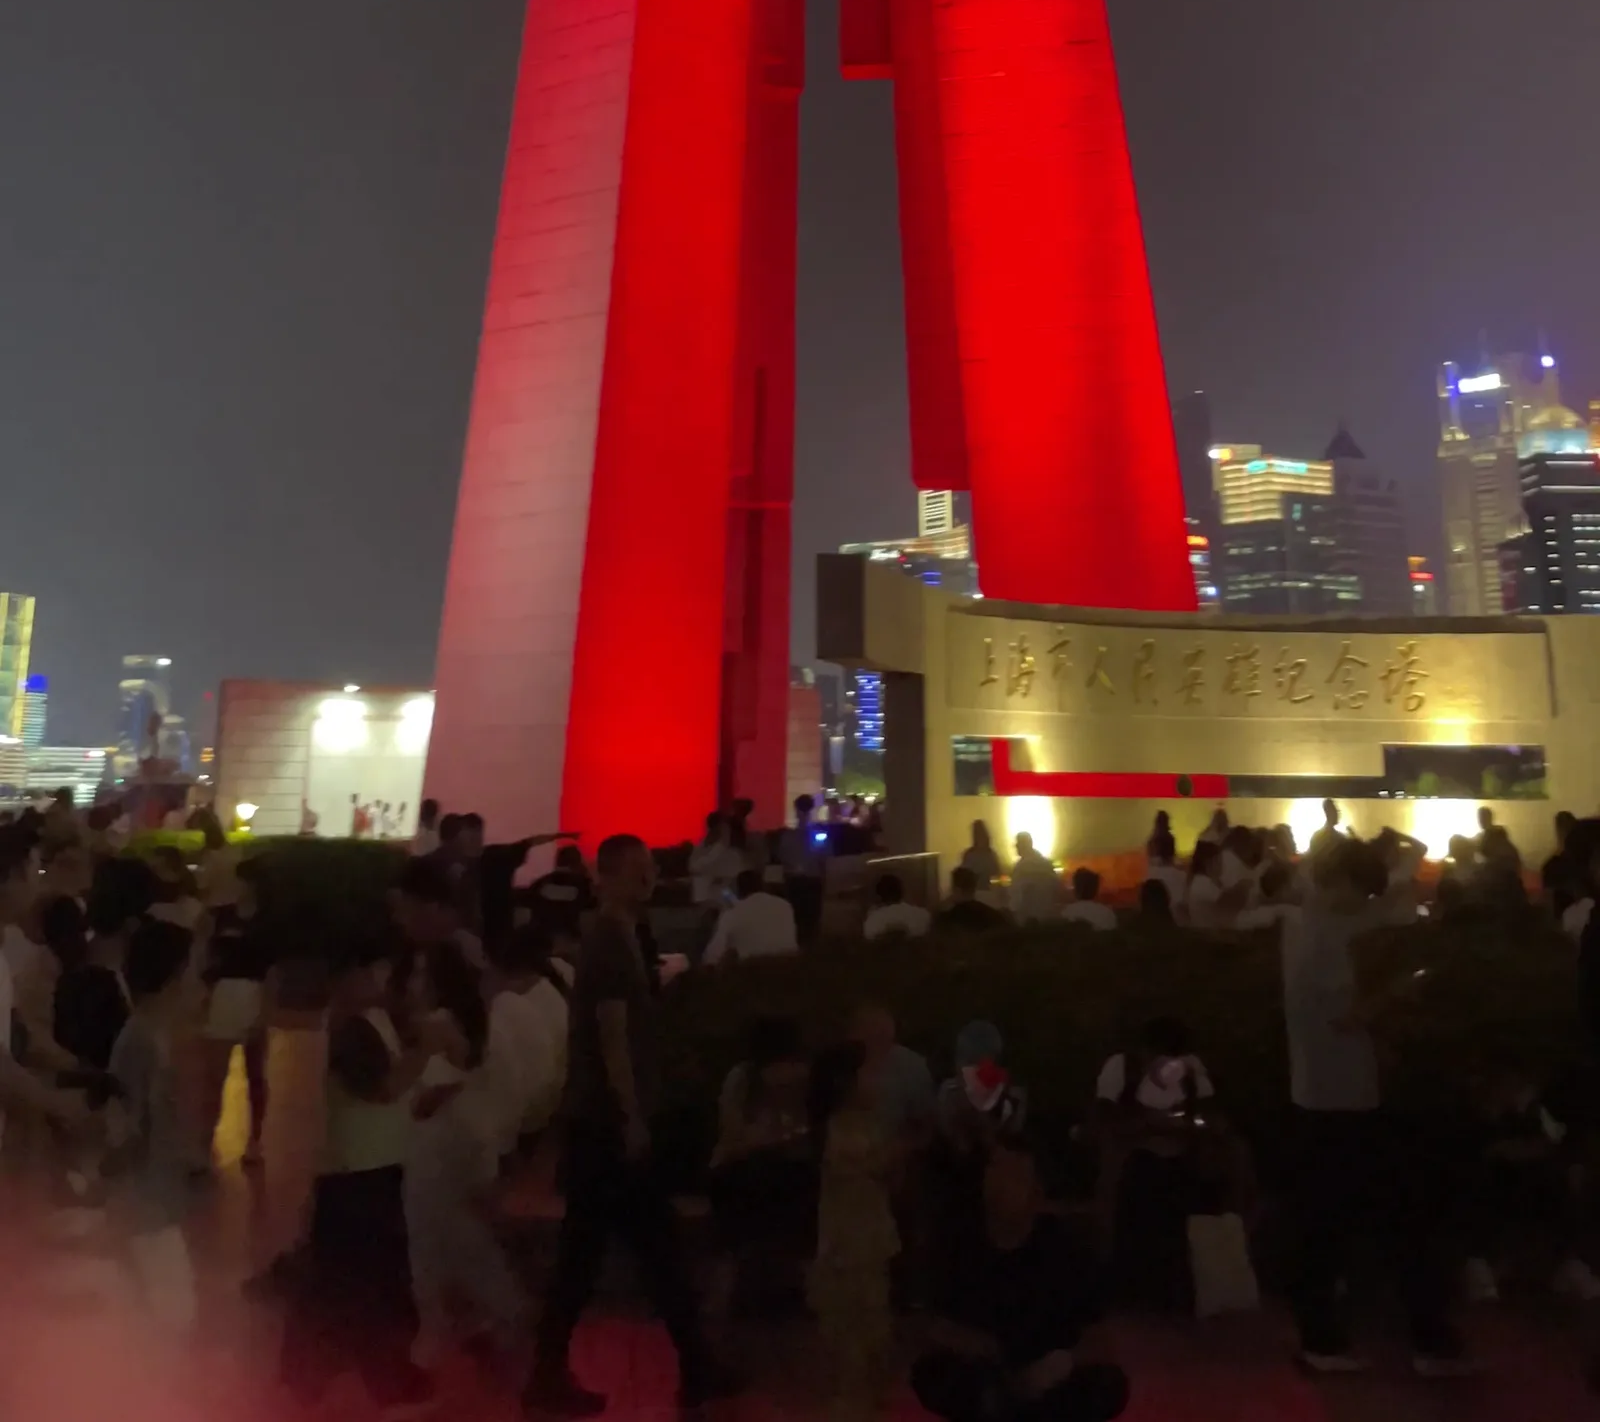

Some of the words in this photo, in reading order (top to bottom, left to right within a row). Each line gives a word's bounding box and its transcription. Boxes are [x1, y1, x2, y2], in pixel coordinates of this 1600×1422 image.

[979, 626, 1429, 712] 上海市人民英雄纪念塔
